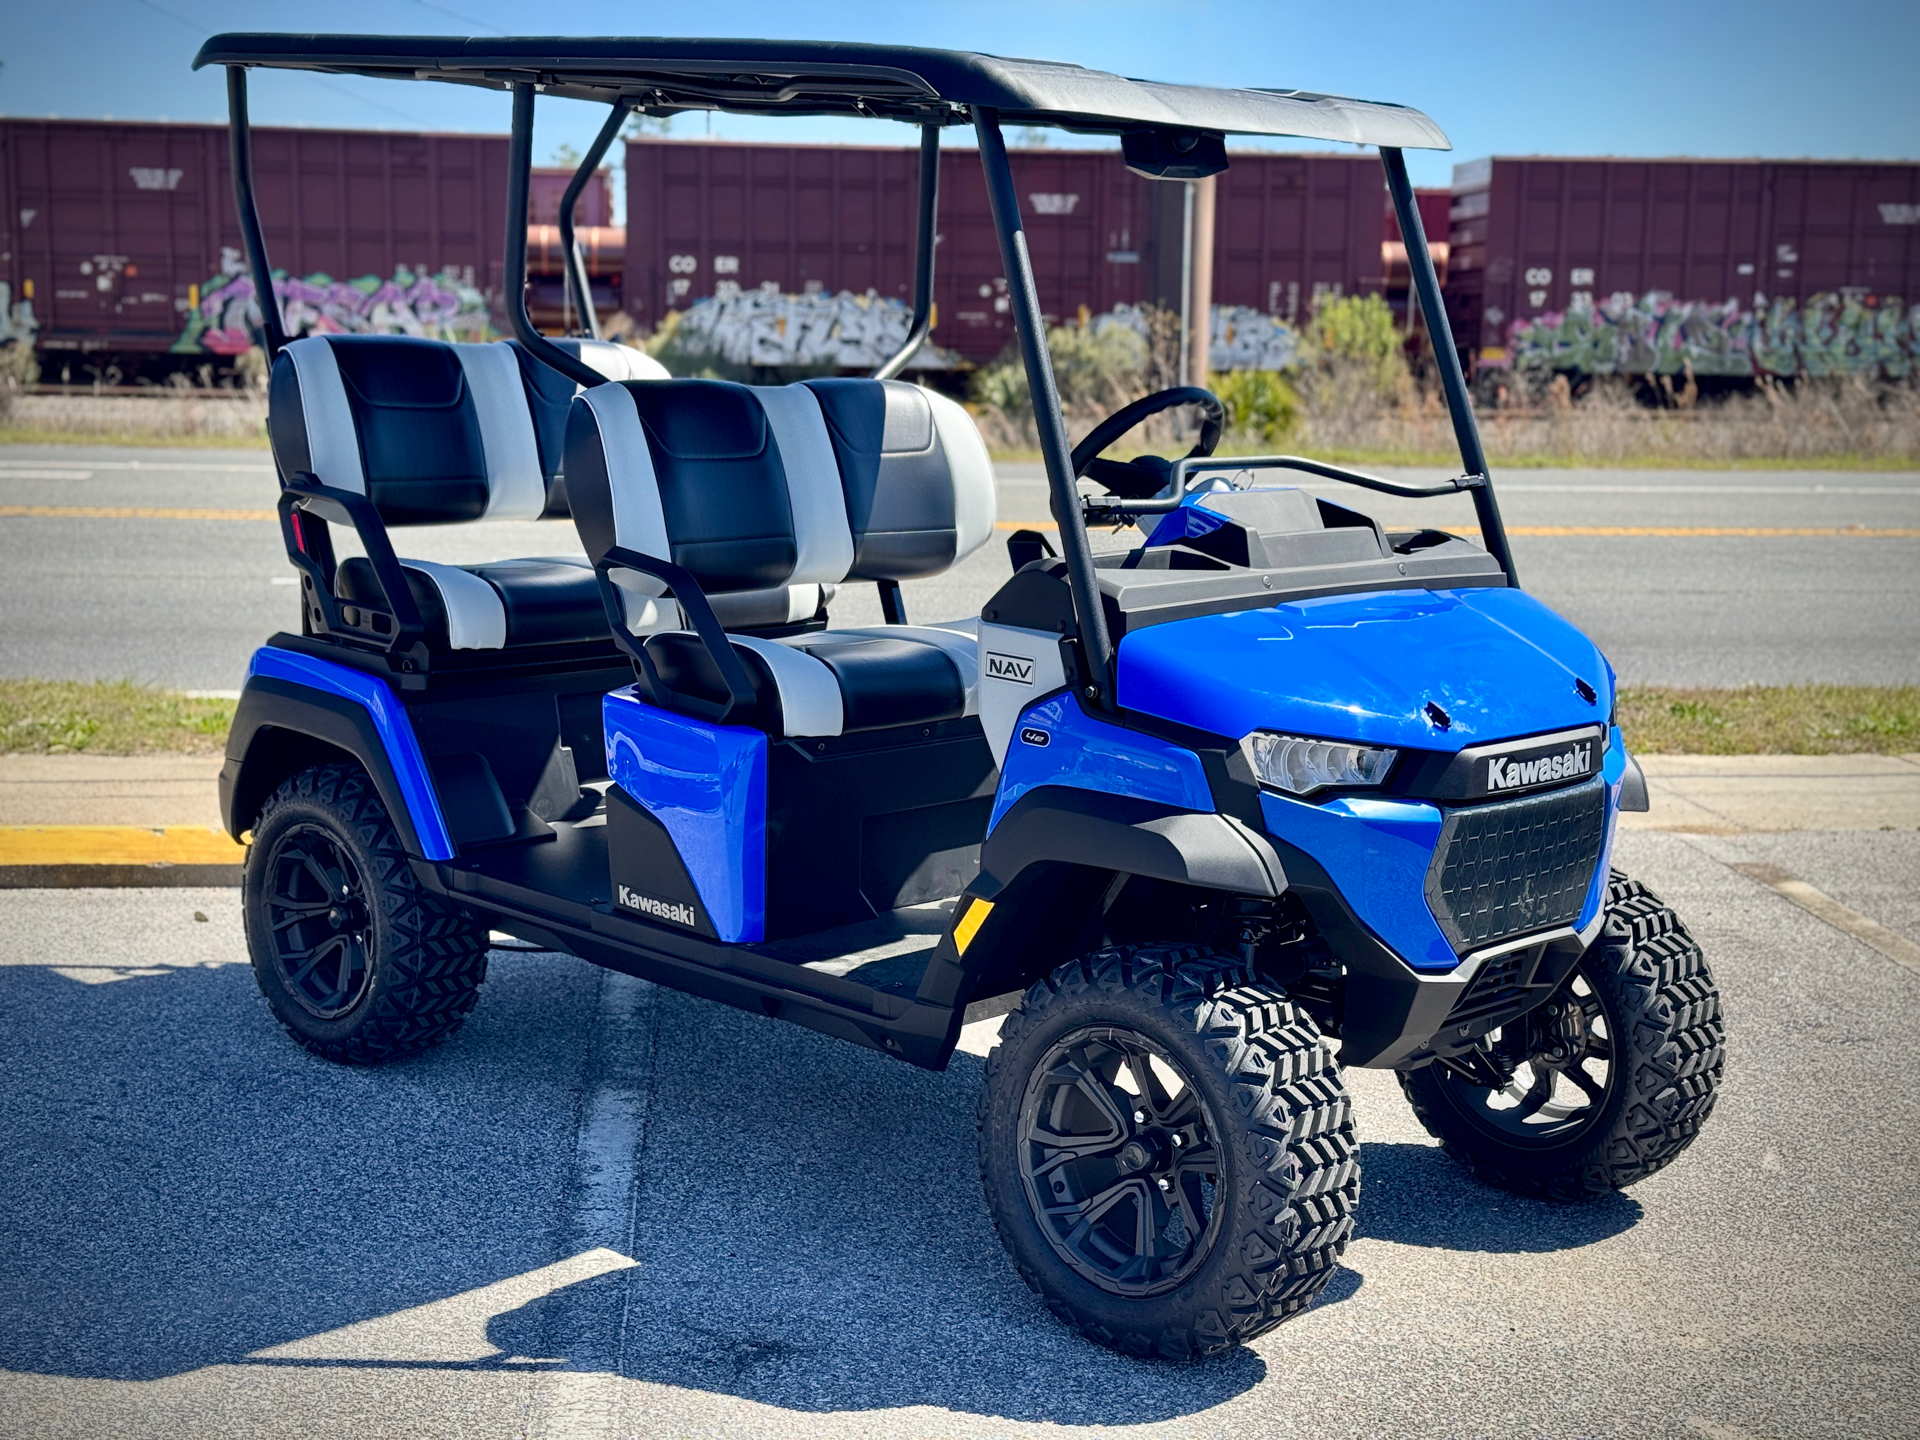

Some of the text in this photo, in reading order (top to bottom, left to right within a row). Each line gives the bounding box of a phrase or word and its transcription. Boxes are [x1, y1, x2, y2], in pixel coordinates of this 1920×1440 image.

[668, 254, 740, 274] CO ER
[1525, 267, 1595, 286] CO ER
[989, 658, 1032, 679] NAV
[1487, 742, 1592, 791] Kawasaki
[618, 884, 695, 928] Kawasaki
